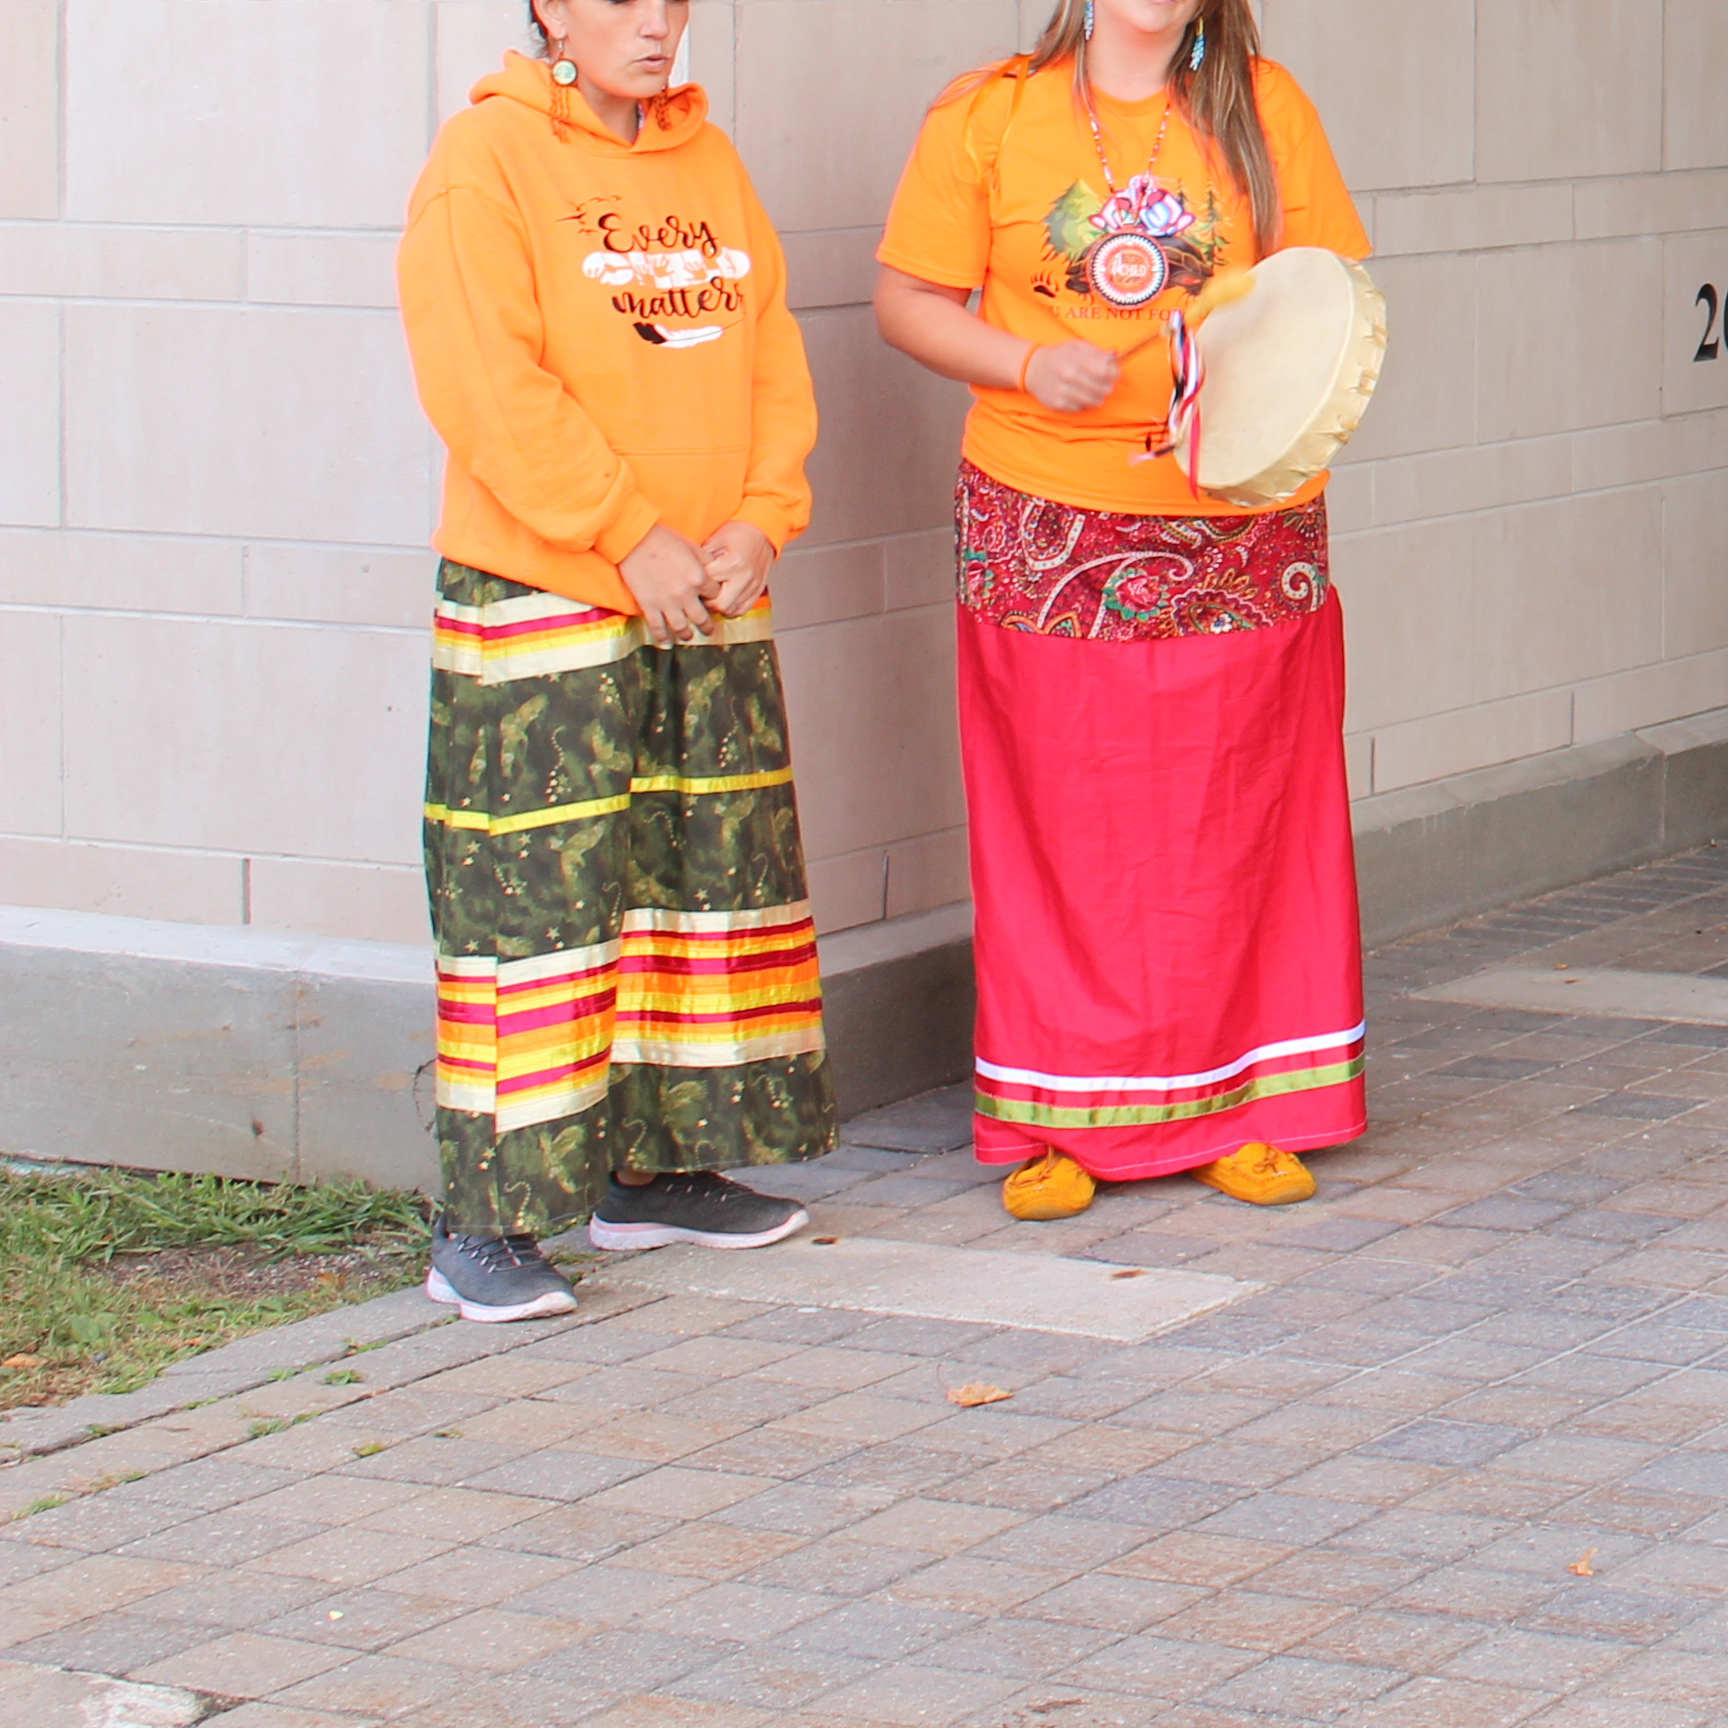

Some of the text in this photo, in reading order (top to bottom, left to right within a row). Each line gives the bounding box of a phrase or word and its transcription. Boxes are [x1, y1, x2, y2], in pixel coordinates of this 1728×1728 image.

[597, 212, 719, 259] Every
[1061, 305, 1101, 320] ARE
[1106, 308, 1144, 321] NOT
